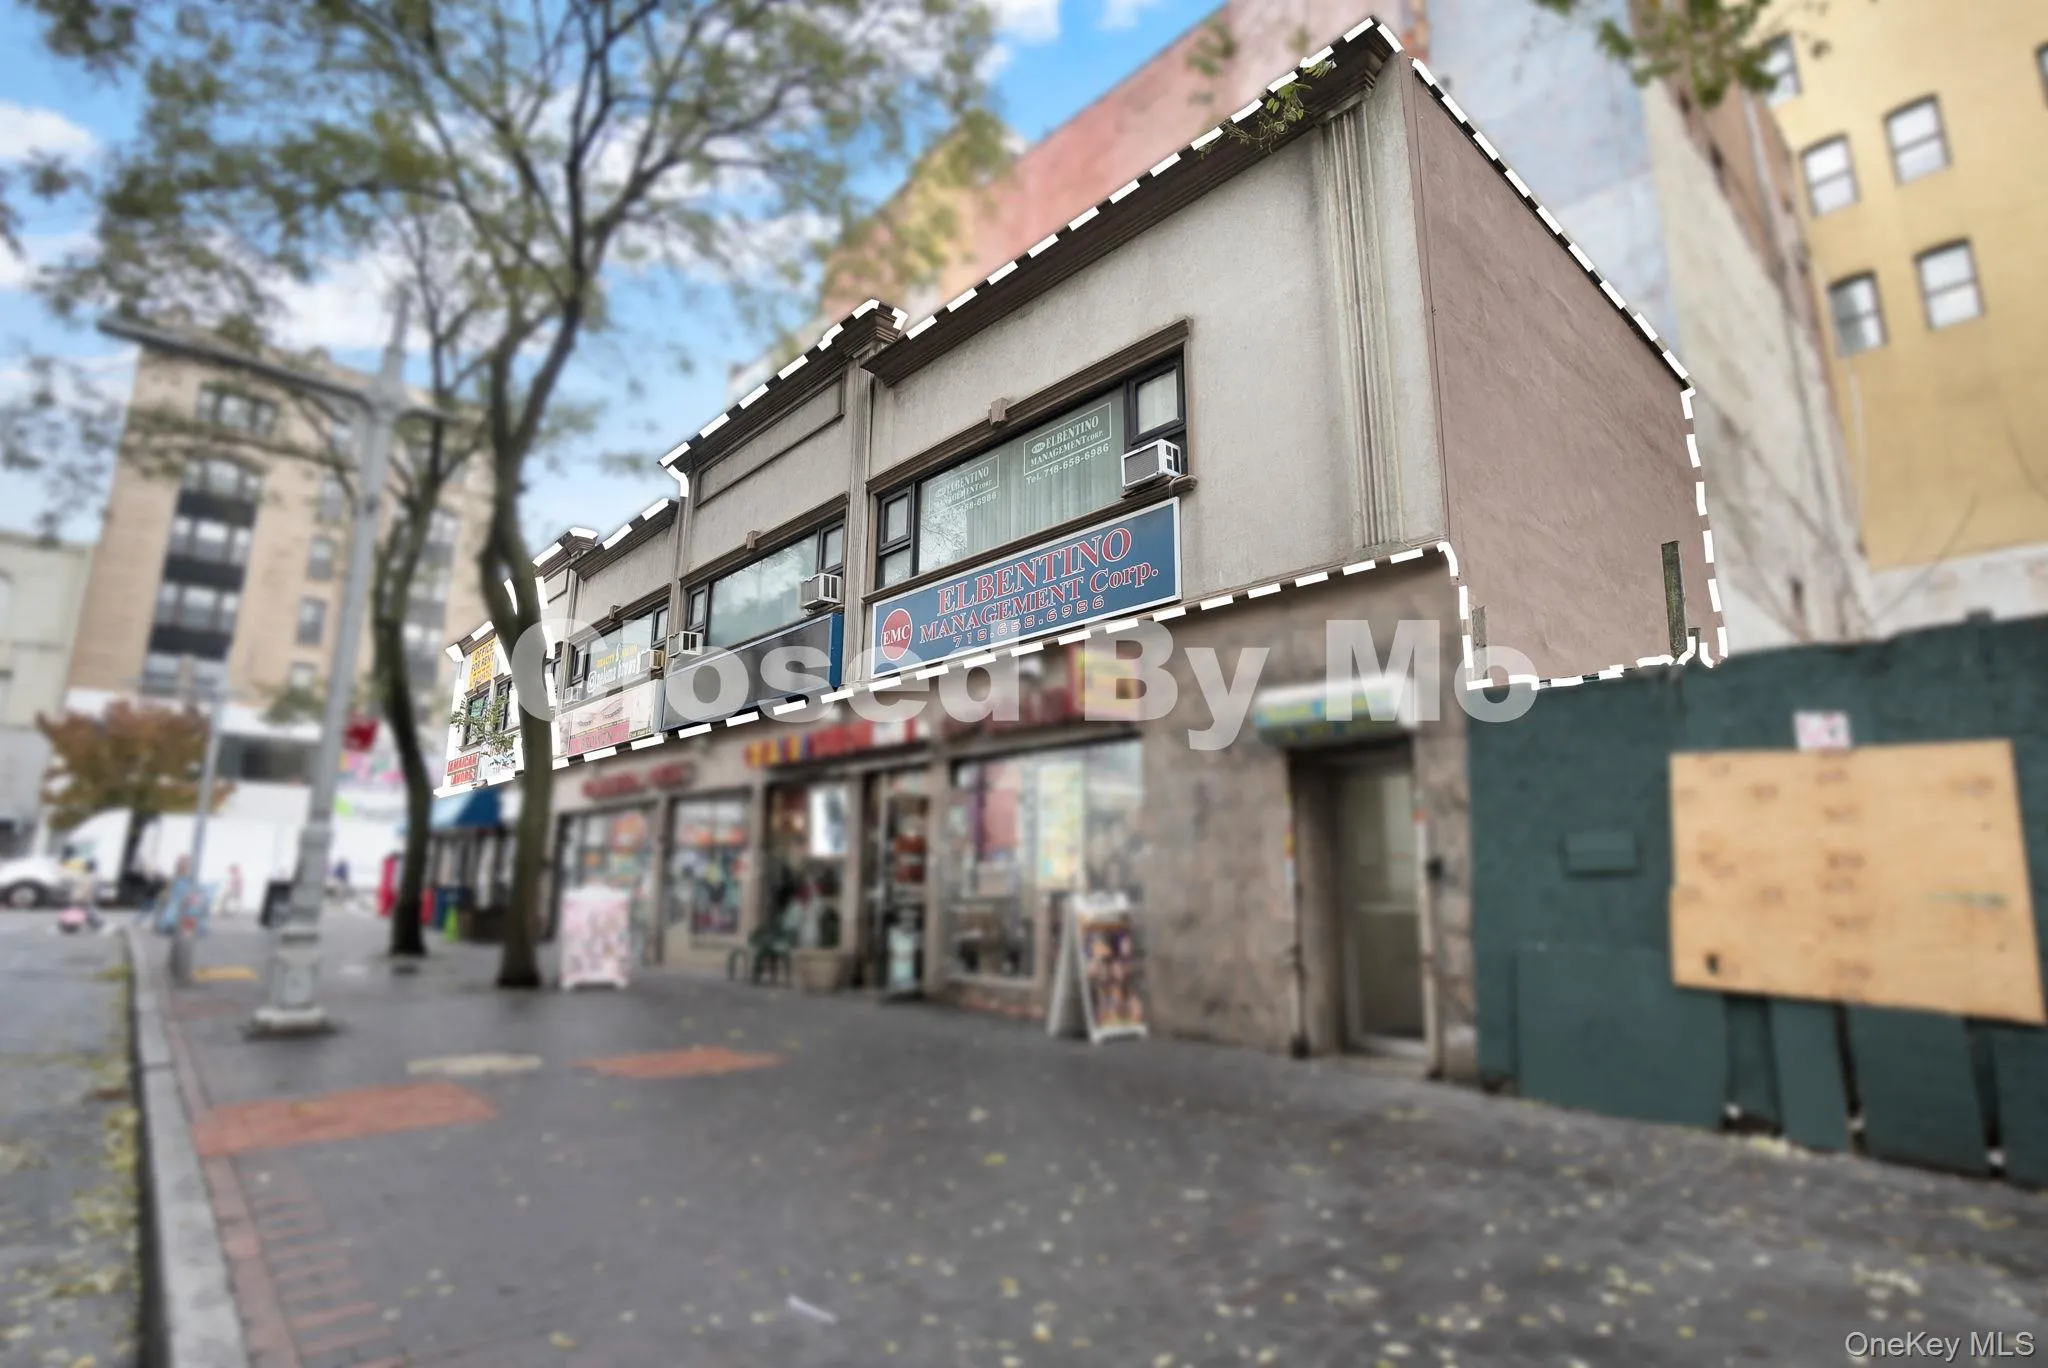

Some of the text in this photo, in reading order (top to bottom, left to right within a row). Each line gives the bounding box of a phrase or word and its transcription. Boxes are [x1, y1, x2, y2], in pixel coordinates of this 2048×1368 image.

[1045, 415, 1099, 449] ELBENTINO
[1030, 435, 1087, 467] MANAGEMENT
[1044, 443, 1109, 478] 718-658-6986
[937, 527, 1132, 616] ELBENTINO
[919, 562, 1159, 644] MANAGEMENT Corp.
[883, 624, 912, 646] EMC
[952, 595, 1105, 648] 718.658.6986
